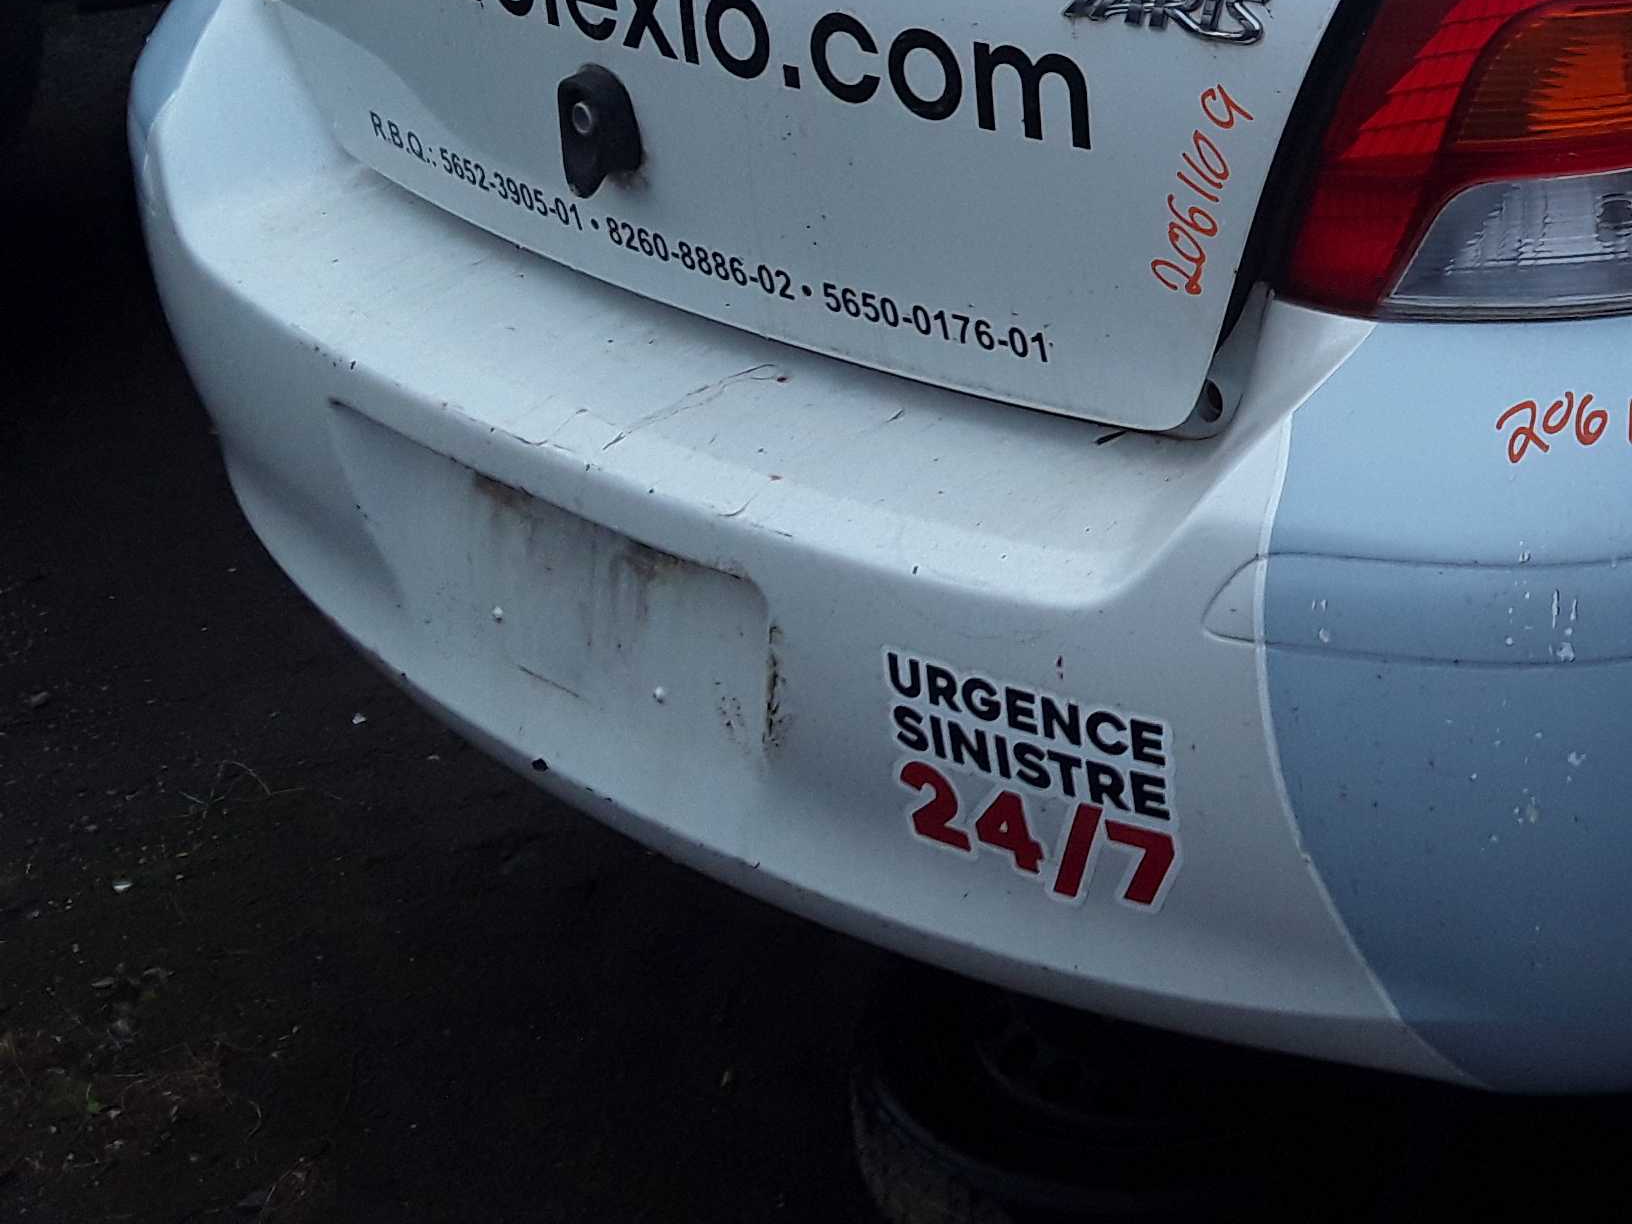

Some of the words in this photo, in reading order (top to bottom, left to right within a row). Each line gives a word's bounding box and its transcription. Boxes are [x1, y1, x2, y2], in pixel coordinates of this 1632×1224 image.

[439, 147, 583, 231] 5652-3905-01
[606, 216, 796, 300] 8260-8886-02
[823, 282, 1049, 363] 5650-0176-01
[886, 652, 1167, 767] URGENCE
[893, 706, 1171, 820] SINISTRE
[900, 761, 1176, 906] 24/7
